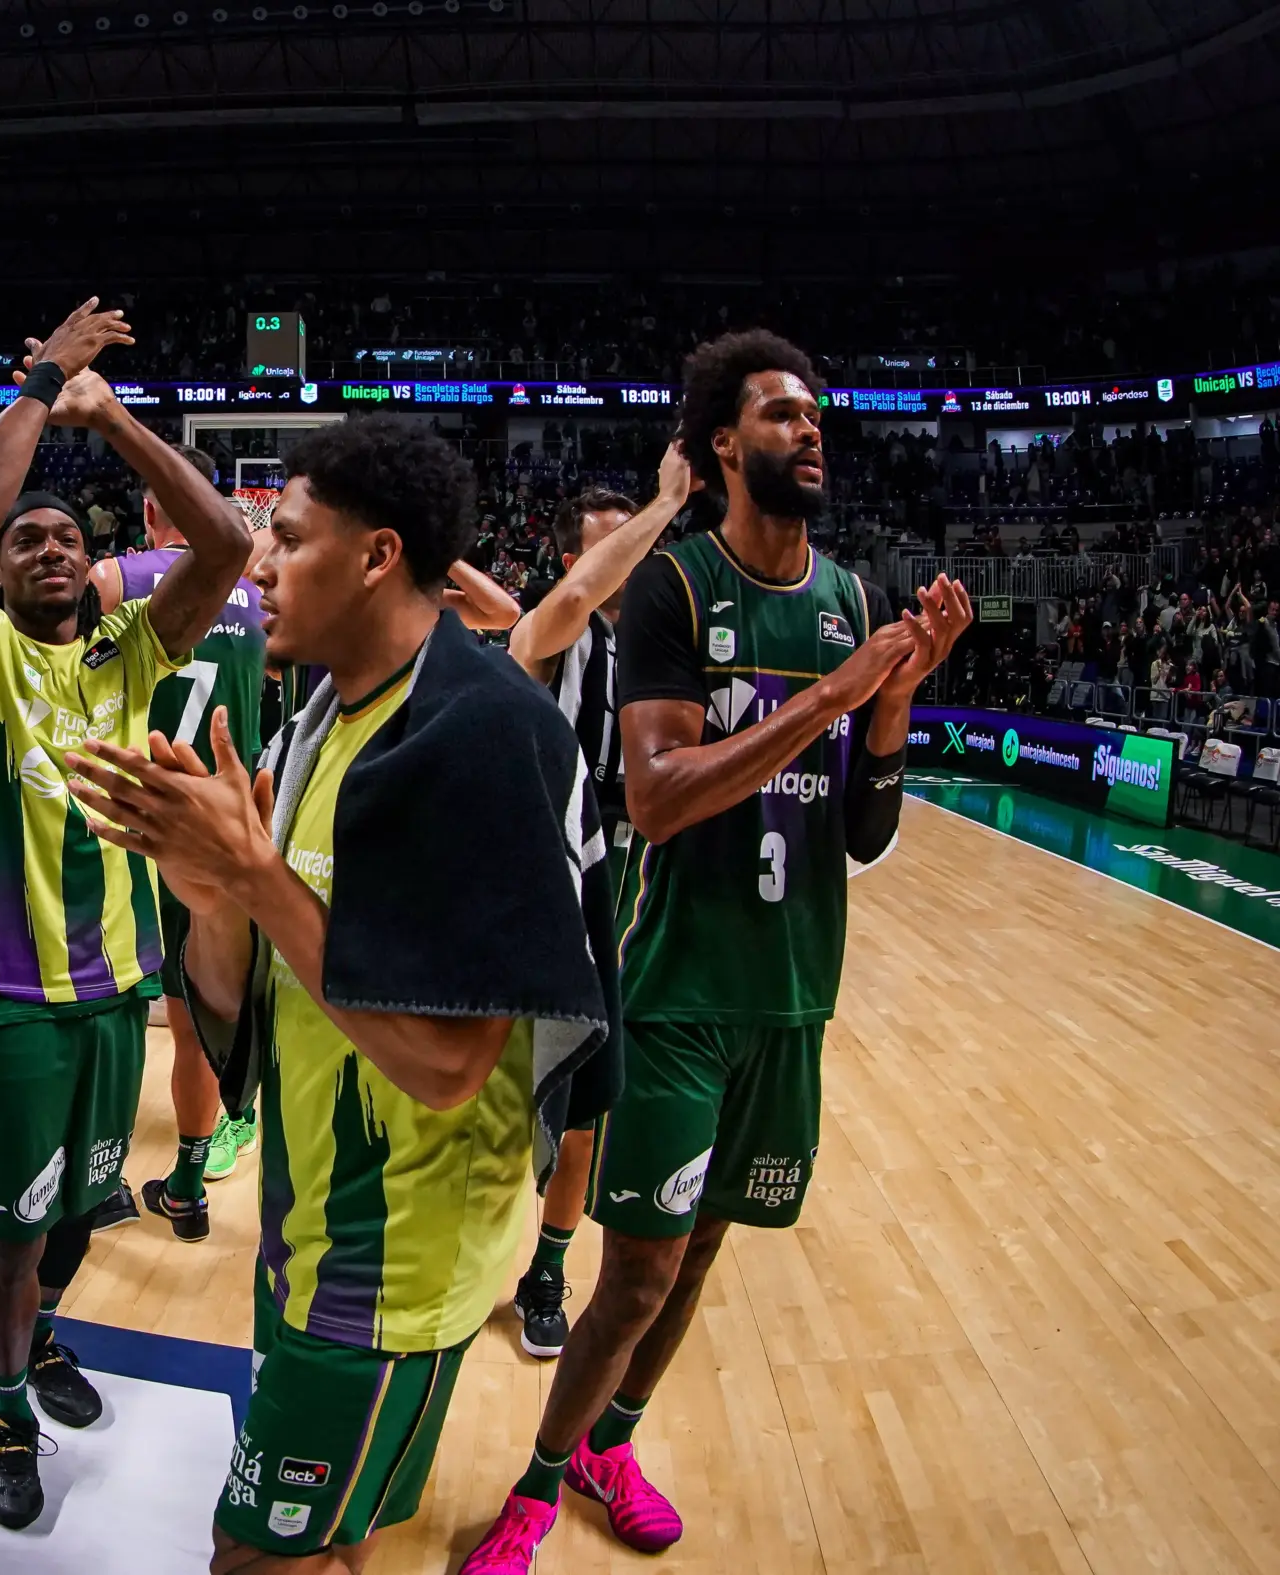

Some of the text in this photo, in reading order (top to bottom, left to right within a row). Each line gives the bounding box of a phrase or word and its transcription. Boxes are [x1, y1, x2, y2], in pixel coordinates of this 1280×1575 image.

[255, 317, 280, 330] 0.3
[884, 360, 910, 368] Unicaja
[266, 368, 294, 377] Unicaja
[415, 384, 487, 393] Recoletas Salud
[1194, 371, 1253, 394] Unicaja VS
[1257, 377, 1272, 388] San
[115, 385, 144, 394] Sábado
[177, 388, 214, 401] 18:00
[217, 388, 226, 401] H
[343, 385, 411, 402] Unicaja VS
[556, 384, 587, 394] Sábado
[122, 396, 160, 404] diciembre
[415, 392, 493, 404] San Pablo Burgos
[540, 395, 551, 404] 13
[553, 395, 564, 404] de
[566, 395, 604, 405] diciembre
[621, 389, 670, 403] 18:00 H
[832, 393, 849, 406] VS
[853, 391, 921, 402] Recoletas Salud
[985, 391, 1013, 400] Sábado
[1045, 390, 1091, 406] 18:00 H
[853, 401, 927, 412] San Pablo Burgos
[971, 402, 981, 411] 13
[982, 401, 991, 411] de
[992, 400, 1029, 410] diciembre
[823, 621, 837, 631] liga
[823, 630, 852, 642] endesa
[85, 652, 100, 664] liga
[176, 661, 219, 745] 7
[966, 733, 995, 752] unicajacb
[1020, 743, 1080, 771] unicajabaloncesto
[1092, 744, 1161, 791] ¡Síguenos!
[758, 832, 786, 902] 3
[93, 1139, 122, 1167] má
[752, 1153, 790, 1165] sabor
[88, 1160, 118, 1186] laga
[758, 1159, 801, 1184] má
[744, 1179, 796, 1208] laga
[284, 1469, 316, 1483] acb
